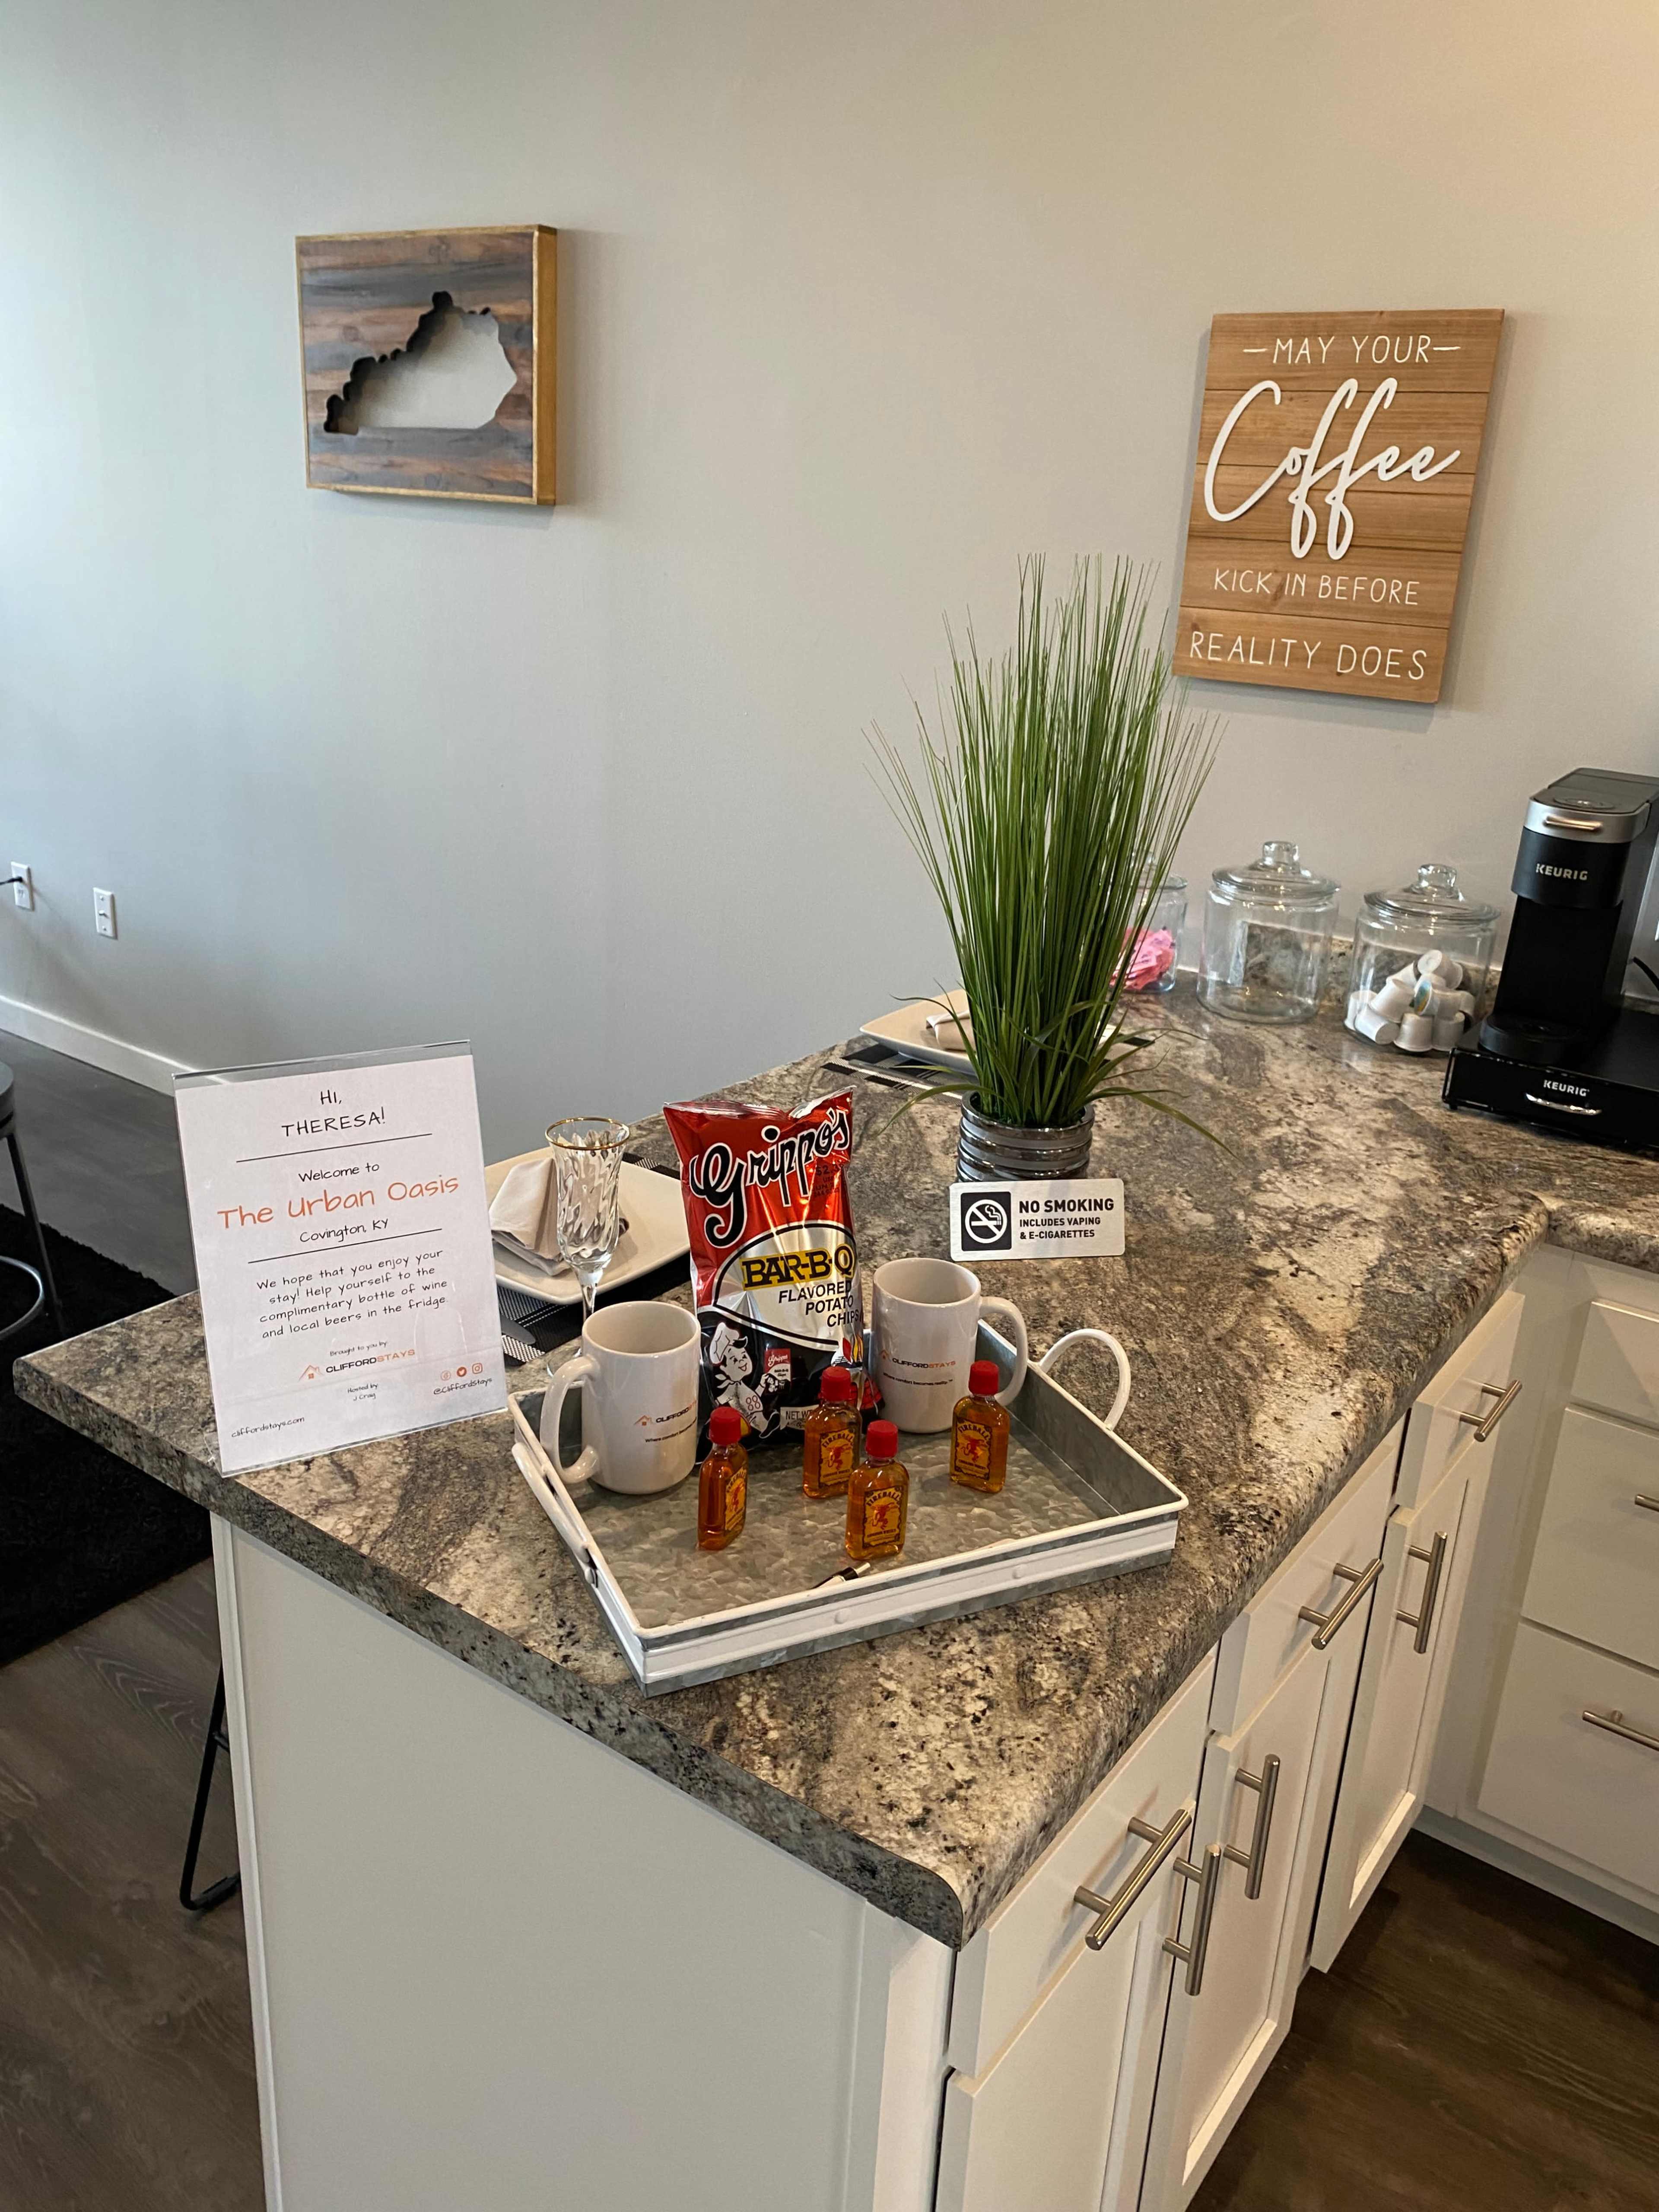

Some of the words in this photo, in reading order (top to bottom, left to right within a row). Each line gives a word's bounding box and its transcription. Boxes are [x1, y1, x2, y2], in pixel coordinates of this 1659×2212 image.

[1273, 336, 1335, 364] MAY
[1352, 335, 1432, 364] YOUR
[1204, 378, 1461, 560] Coffee
[1214, 569, 1272, 595] KICK
[1284, 573, 1307, 597] IN
[1319, 575, 1420, 605] BEFORE
[1190, 630, 1322, 669] REALITY
[1336, 644, 1427, 680] DOES
[1536, 863, 1588, 880] KEURIG
[320, 1090, 342, 1105] HI,
[1544, 1080, 1587, 1096] KEURIG
[281, 1106, 386, 1137] THERESA!
[298, 1165, 360, 1183] Welcome
[365, 1162, 380, 1173] to
[689, 1107, 850, 1248] Grippo's
[217, 1205, 274, 1229] The
[289, 1189, 375, 1218] Urban
[388, 1174, 459, 1200] Oasis
[1019, 1200, 1040, 1214] NO
[1044, 1198, 1114, 1213] SMOKING
[299, 1223, 367, 1243] Covington,
[372, 1219, 389, 1231] KY
[1020, 1218, 1065, 1227] INCLUDES
[1067, 1217, 1101, 1226] VAPING
[1020, 1231, 1027, 1239] &
[1029, 1229, 1095, 1239] E-CIGARETTES
[257, 1279, 276, 1290] We
[283, 1273, 313, 1290] hope
[319, 1267, 344, 1279] that
[351, 1263, 372, 1278] you
[378, 1257, 409, 1271] enjoy
[415, 1249, 443, 1265] your
[742, 1244, 855, 1287] BAR-B-Q
[269, 1287, 300, 1306] stay!
[306, 1286, 332, 1299] Help
[338, 1273, 392, 1295] yourself
[398, 1271, 410, 1280] to
[416, 1266, 435, 1276] the
[778, 1280, 852, 1304] FLAVORED
[260, 1300, 353, 1323] complimentary
[358, 1289, 395, 1303] bottle
[401, 1283, 415, 1295] of
[422, 1279, 448, 1291] wine
[805, 1294, 854, 1316] POTATO
[262, 1326, 284, 1339] and
[289, 1319, 319, 1333] local
[325, 1312, 362, 1326] beers
[367, 1308, 378, 1318] in
[383, 1304, 402, 1315] the
[826, 1309, 859, 1327] CHIPS
[330, 1347, 354, 1357] Brought
[367, 1343, 378, 1351] you
[326, 1349, 415, 1373] CLIFFORDSTAYS
[892, 1358, 956, 1368] CLIFFORDSTAYS
[347, 1384, 369, 1393] Hosted
[785, 1410, 800, 1420] NET
[232, 1417, 305, 1438] cliffordstays.com
[958, 1424, 988, 1440] FIREBALL
[822, 1433, 853, 1448] FIREBALL
[866, 1491, 900, 1507] FIREBALL
